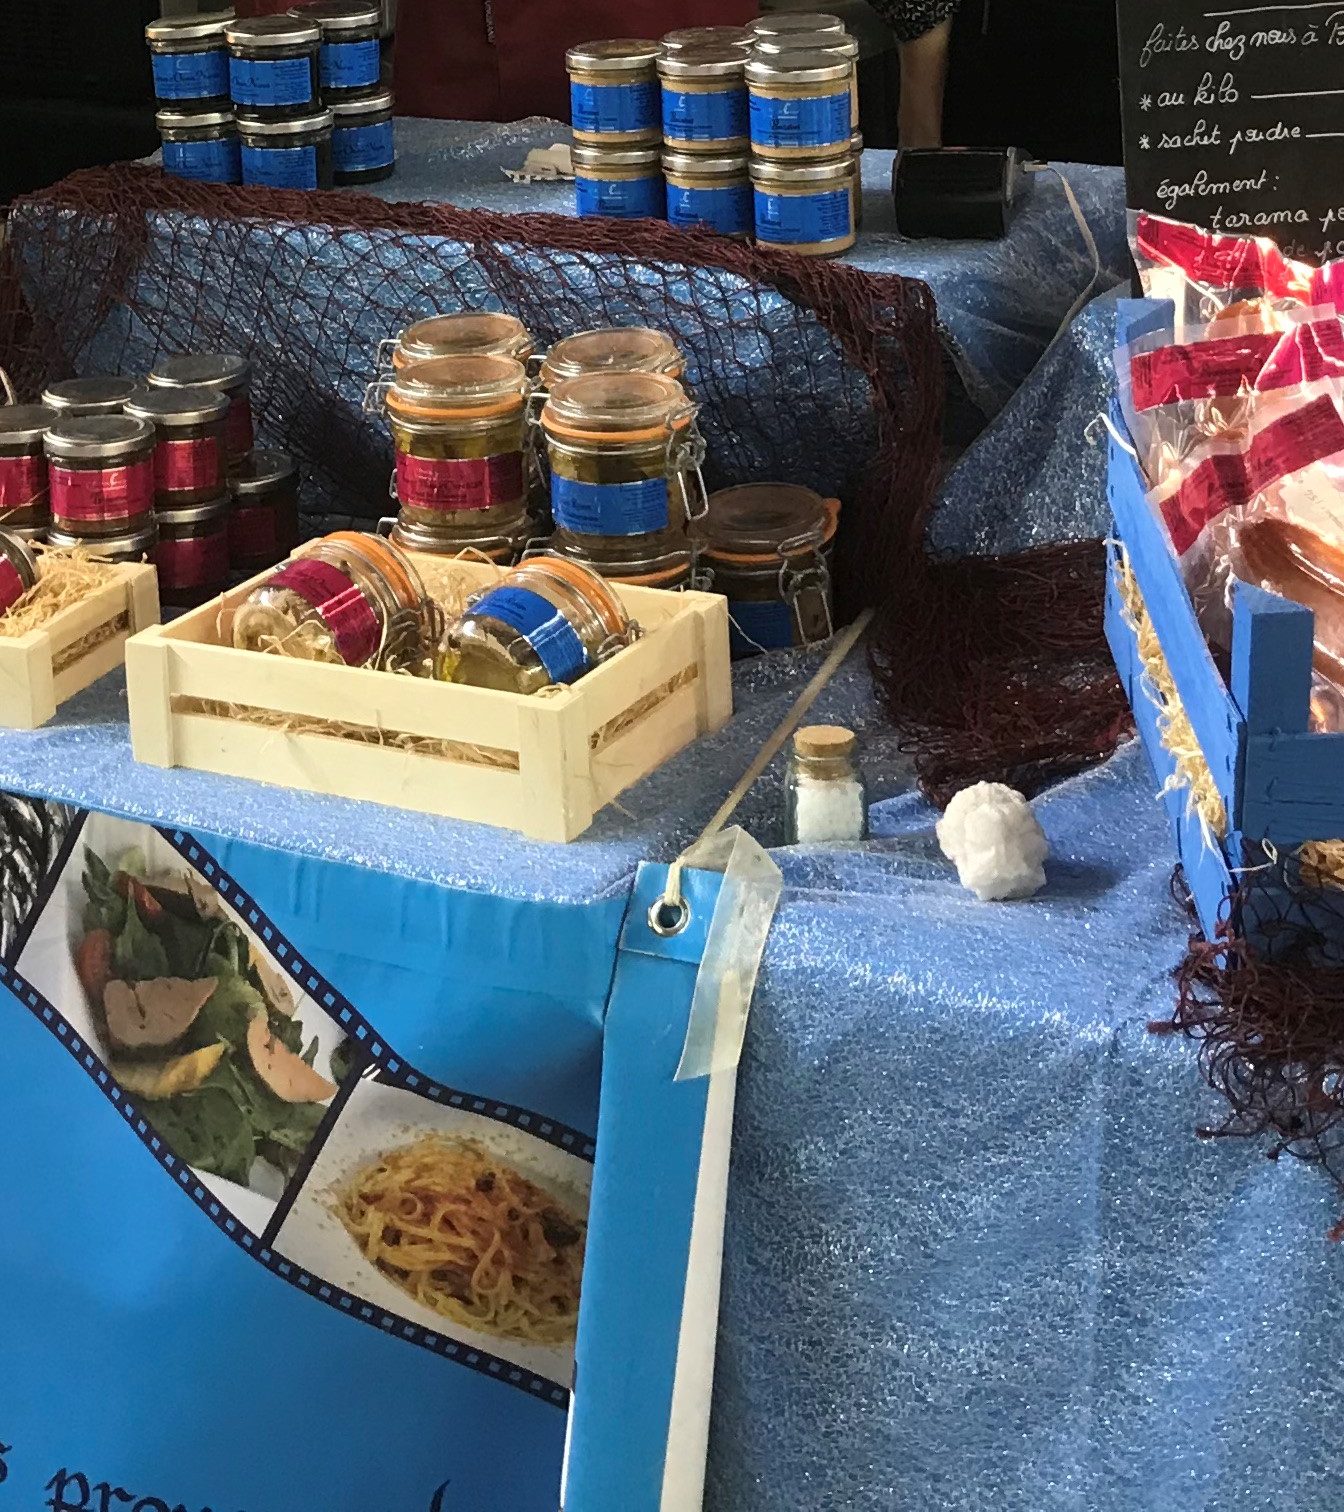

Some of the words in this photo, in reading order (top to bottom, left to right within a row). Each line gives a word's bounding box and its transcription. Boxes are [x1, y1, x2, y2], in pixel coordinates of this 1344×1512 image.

[1139, 22, 1200, 68] faites
[1206, 20, 1246, 61] chez
[1250, 26, 1297, 47] nous
[1301, 24, 1319, 45] à
[1157, 90, 1185, 107] au
[1194, 72, 1239, 106] kilo
[1157, 127, 1221, 150] sachet
[1229, 124, 1302, 155] poudre
[1210, 206, 1309, 230] tarama
